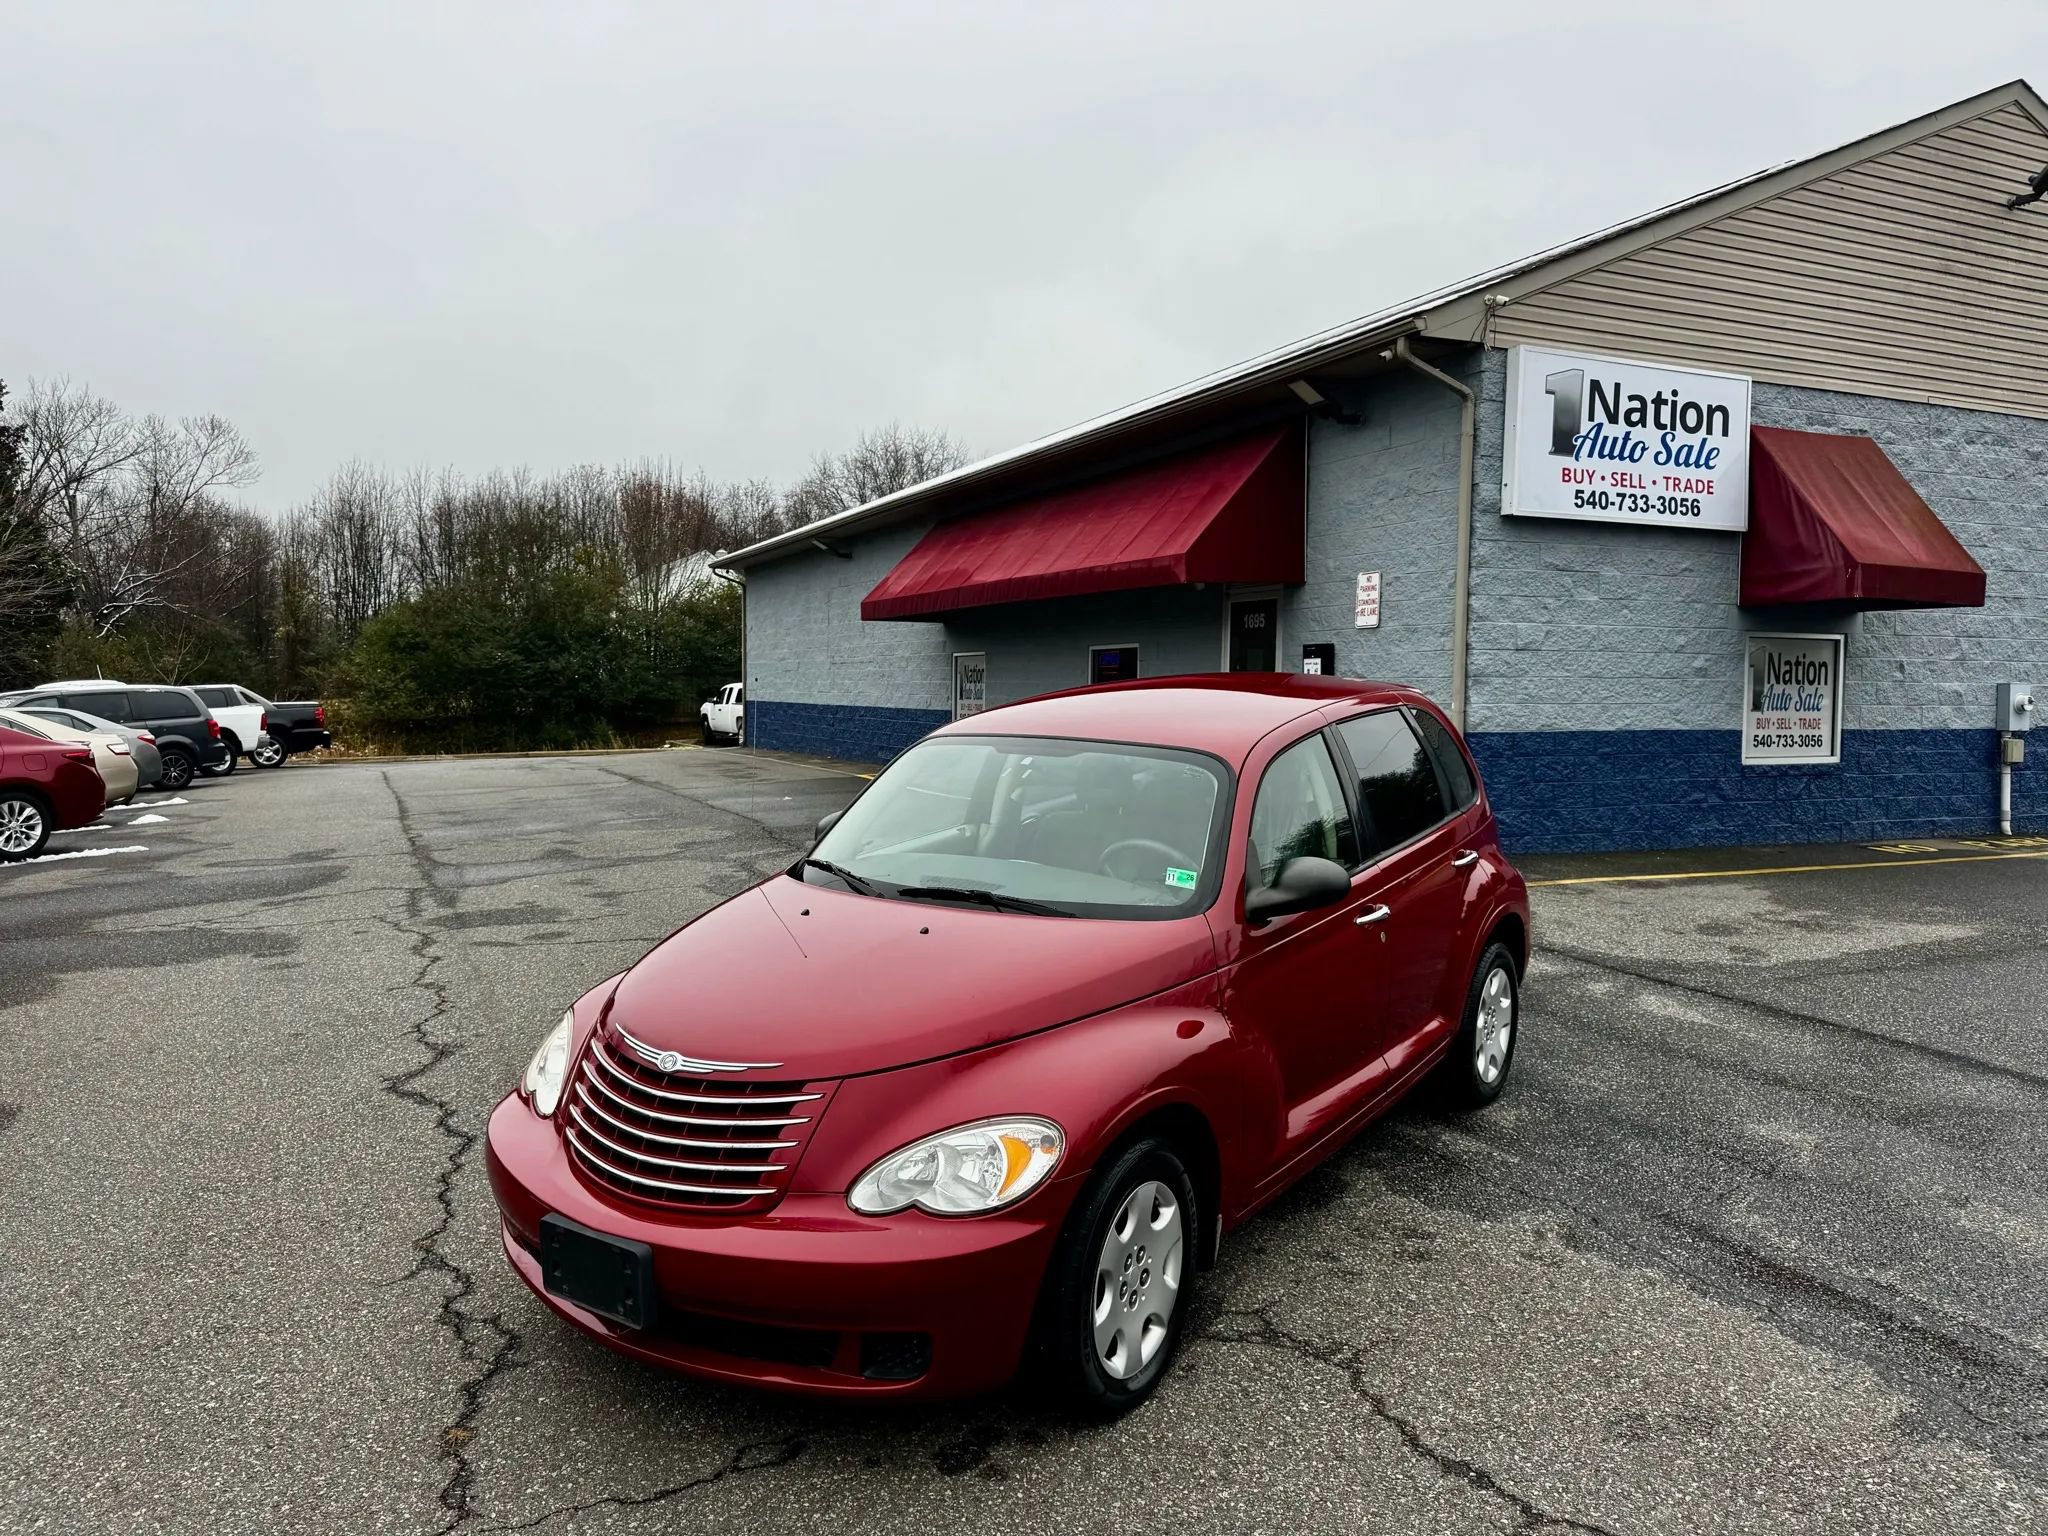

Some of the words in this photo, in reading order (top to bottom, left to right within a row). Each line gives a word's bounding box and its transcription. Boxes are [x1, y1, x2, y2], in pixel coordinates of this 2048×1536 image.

[1545, 368, 1584, 458] 1
[1587, 378, 1730, 438] Nation
[1573, 422, 1649, 463] Auto
[1653, 431, 1721, 471] Sale
[1561, 467, 1596, 485] BUY
[1610, 471, 1647, 490] SELL
[1663, 475, 1715, 495] TRADE
[1573, 489, 1701, 517] 540-733-3056
[1243, 613, 1265, 628] 1695
[1749, 645, 1767, 713] 1
[1767, 652, 1828, 686] Nation
[1760, 684, 1793, 714] Auto
[1794, 685, 1824, 713] Sale
[1756, 718, 1771, 730] BUY
[1776, 718, 1792, 730] SELL
[1798, 718, 1822, 730] TRADE
[1753, 734, 1823, 748] 540-733-3056
